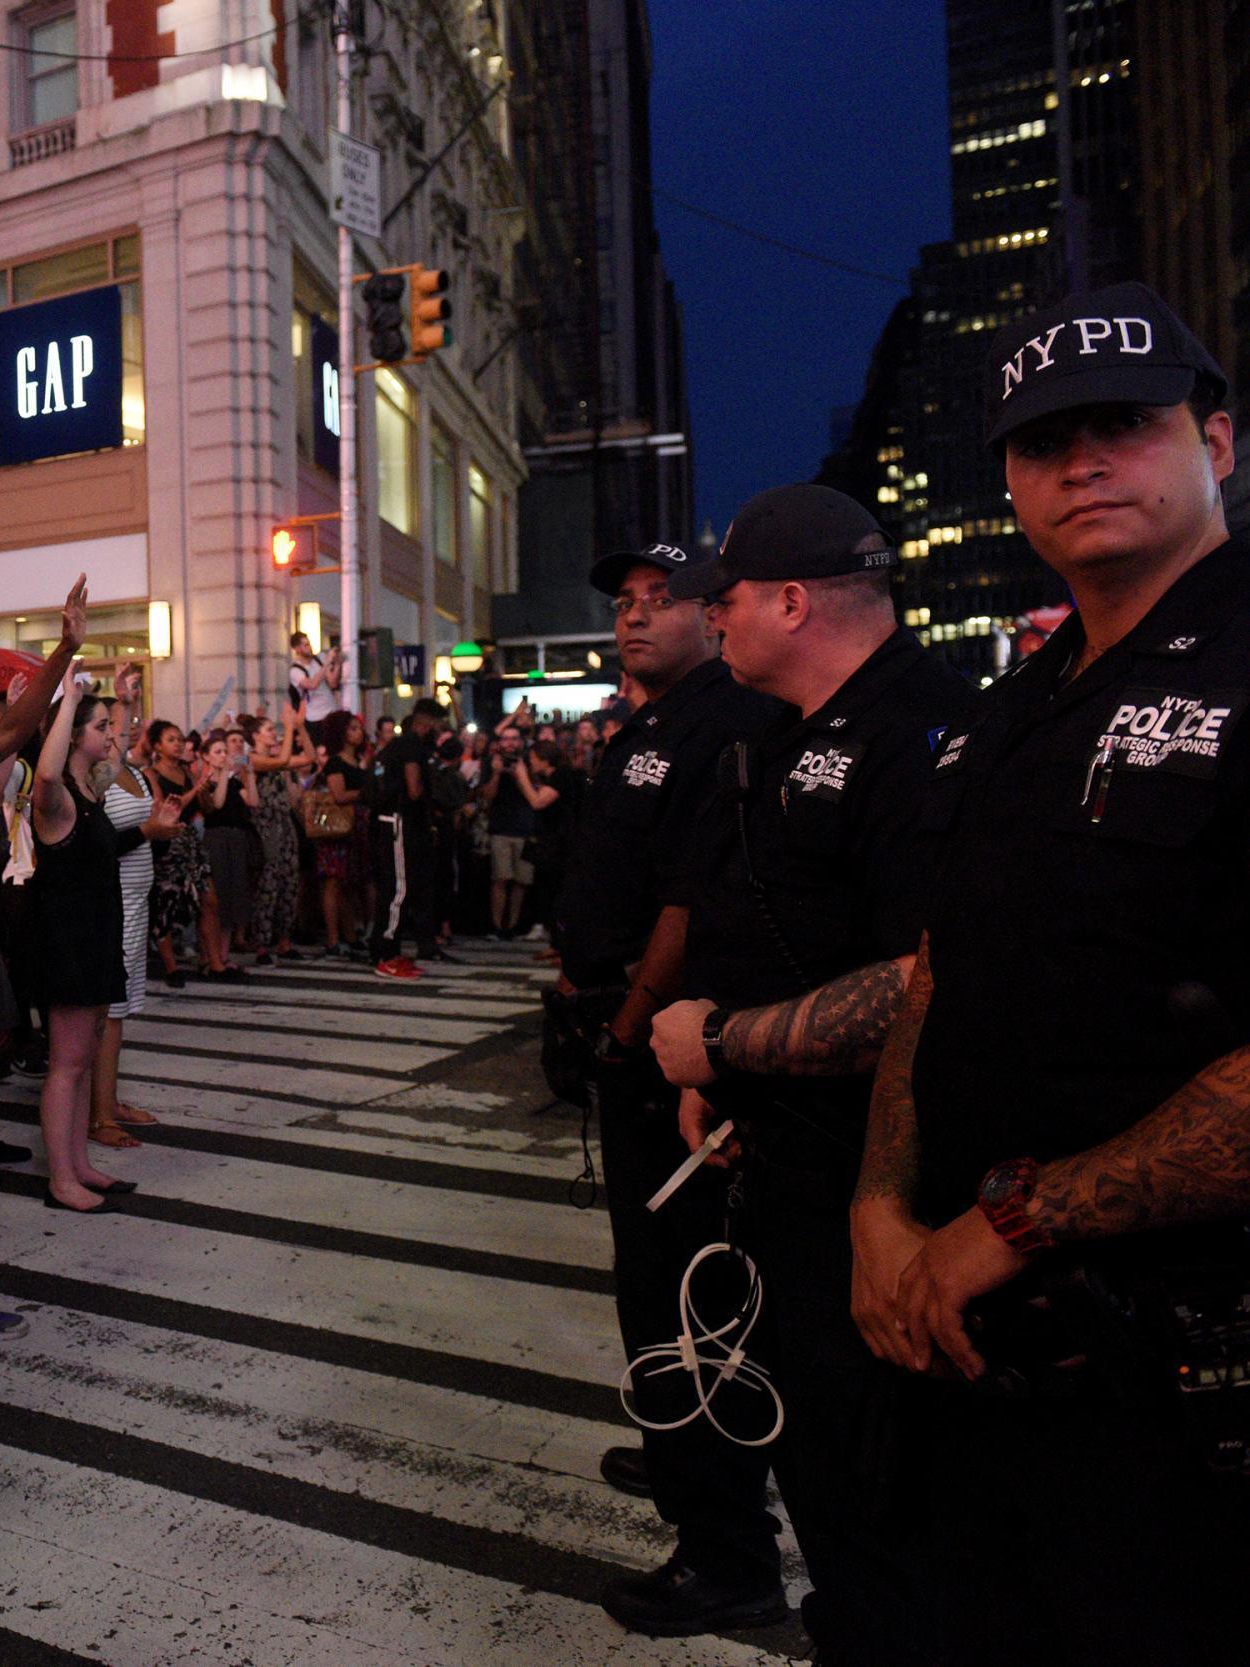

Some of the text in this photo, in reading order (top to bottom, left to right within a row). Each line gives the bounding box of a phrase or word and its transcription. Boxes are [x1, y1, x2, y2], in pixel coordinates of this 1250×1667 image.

[1001, 317, 1153, 400] NYPD
[16, 334, 94, 419] GAP
[648, 543, 687, 562] PD
[1168, 637, 1197, 650] S2
[1106, 705, 1231, 741] POLCE
[796, 751, 854, 779] POCE
[1126, 751, 1169, 767] GRO
